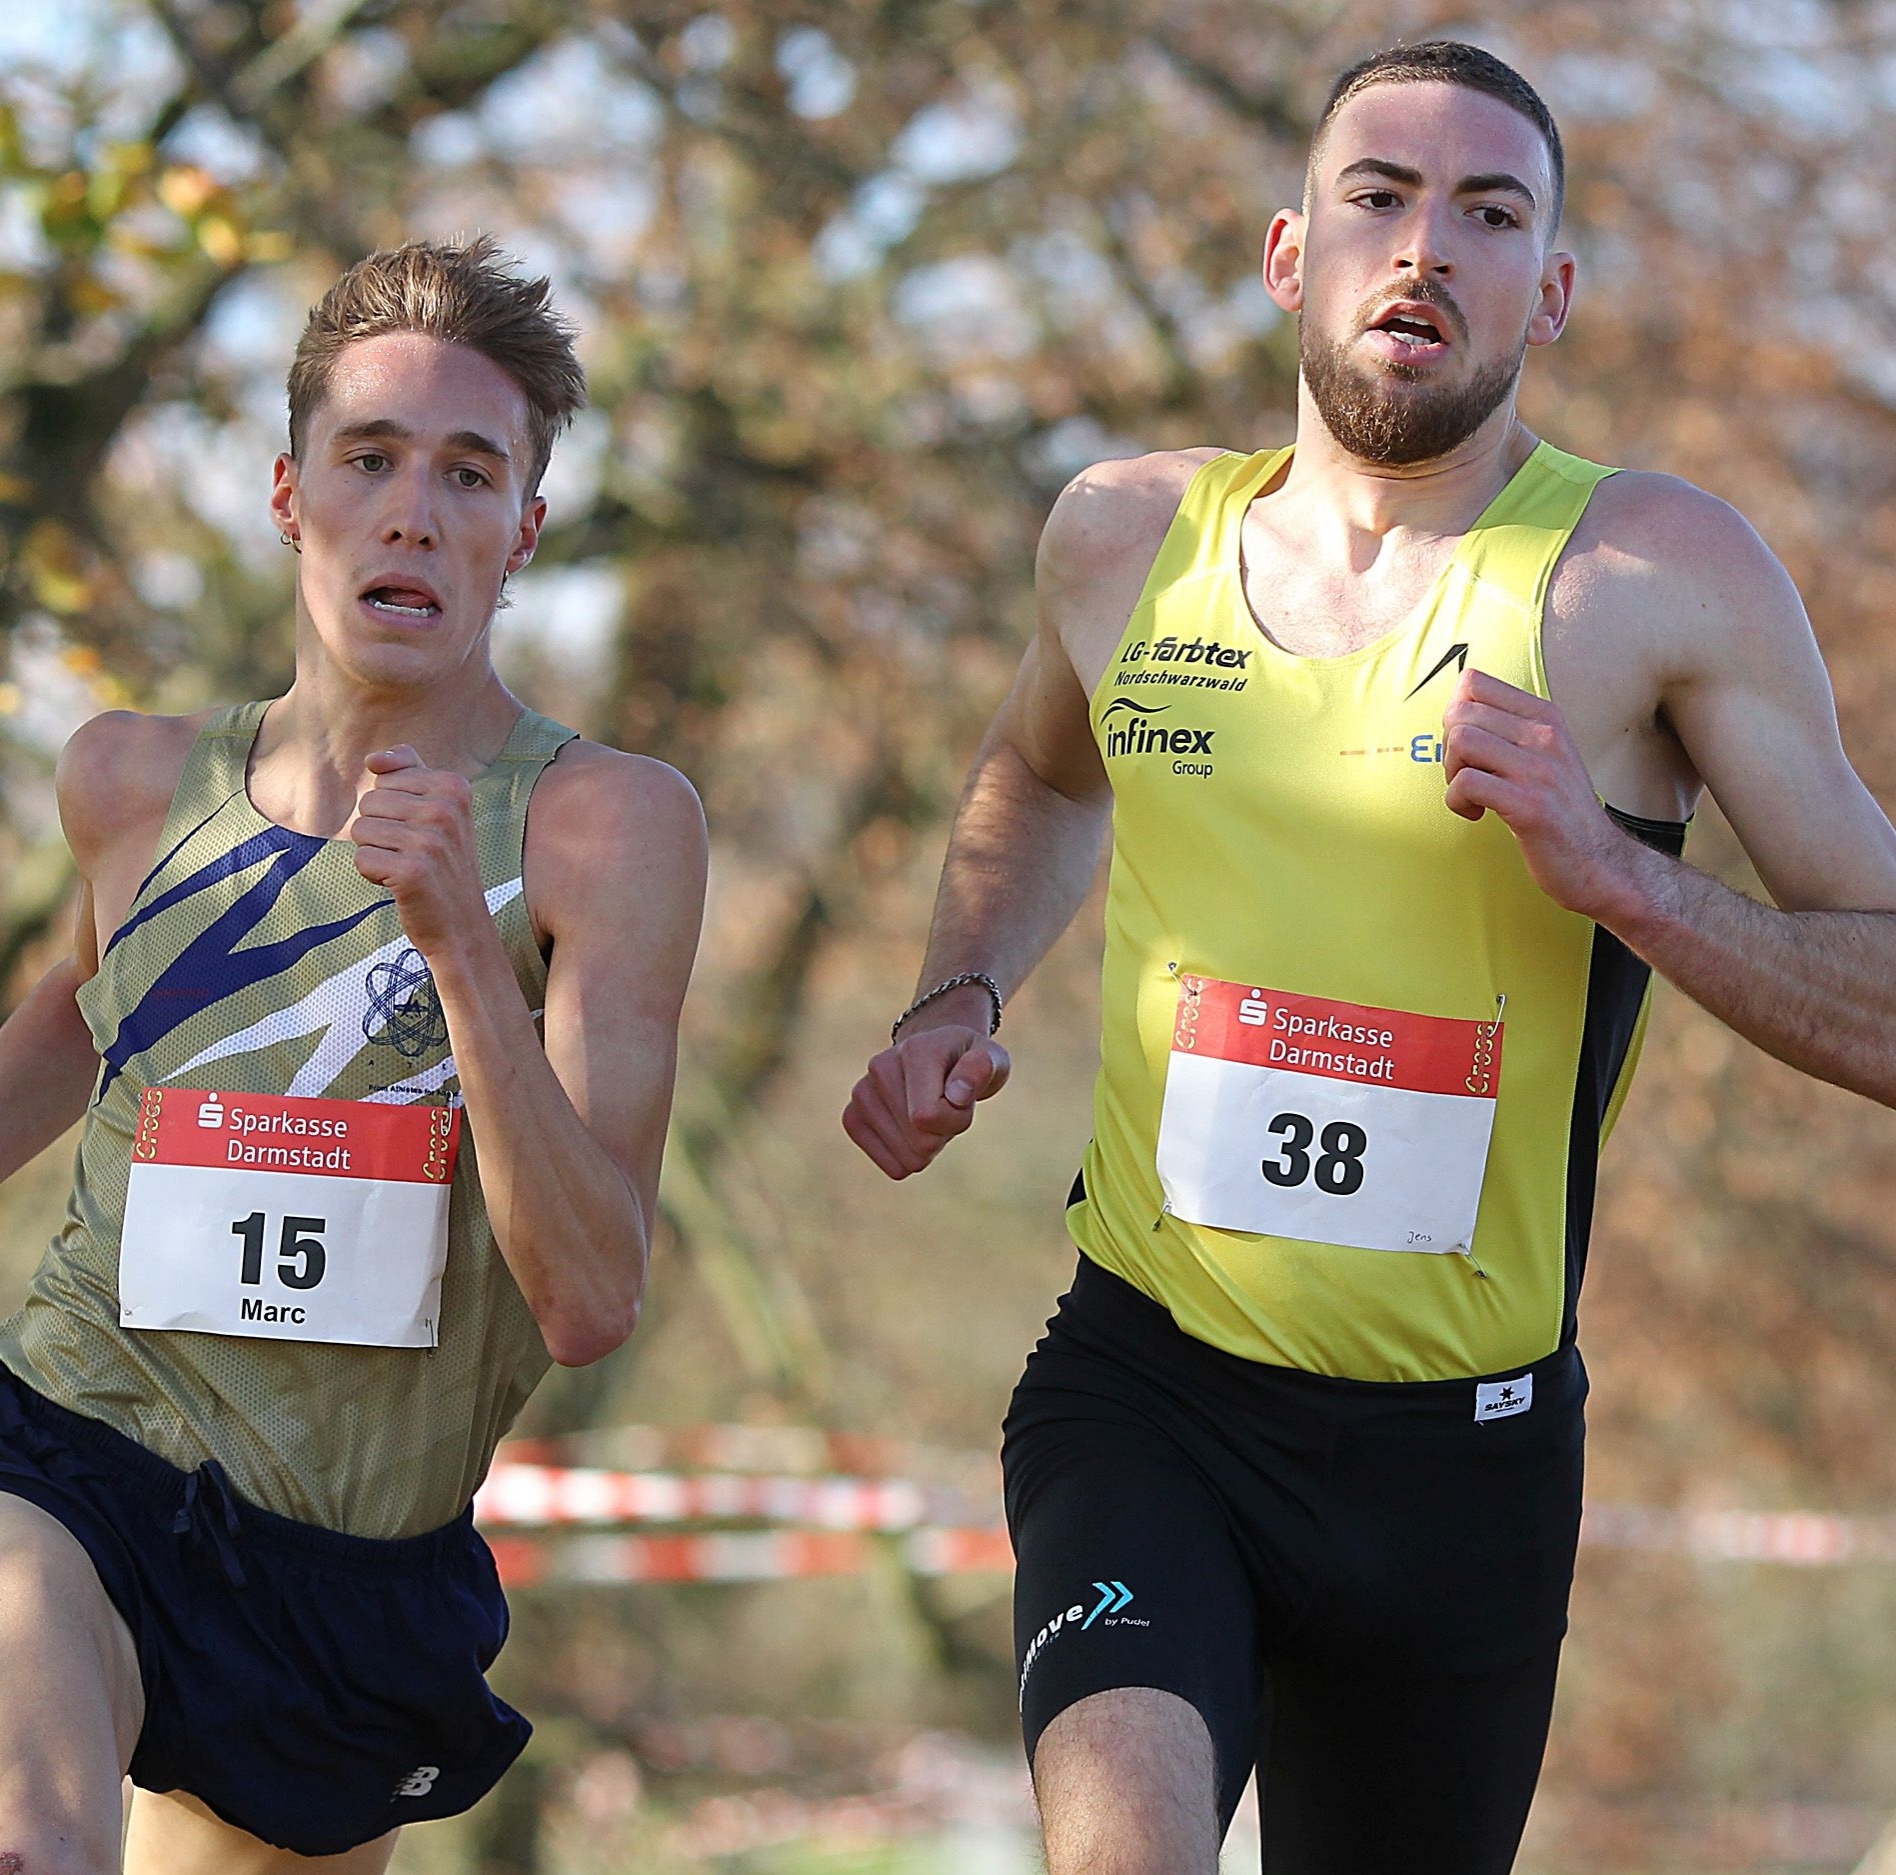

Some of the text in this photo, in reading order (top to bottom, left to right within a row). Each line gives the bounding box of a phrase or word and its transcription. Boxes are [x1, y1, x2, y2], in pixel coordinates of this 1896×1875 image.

[1114, 670, 1248, 692] Nordschwarzwald
[1107, 717, 1215, 758] infinex
[1172, 760, 1213, 779] Group
[1272, 1008, 1394, 1048] Sparkasse
[1269, 1039, 1395, 1081] Darmstadt
[229, 1108, 348, 1139] Sparkasse
[226, 1139, 352, 1171] Darmstadt
[1262, 1112, 1368, 1196] 38
[231, 1211, 327, 1291] 15
[1407, 1230, 1432, 1244] Jens
[240, 1298, 307, 1325] Marc
[1484, 1396, 1526, 1411] SAYSKY
[1105, 1617, 1150, 1627] by Pudel
